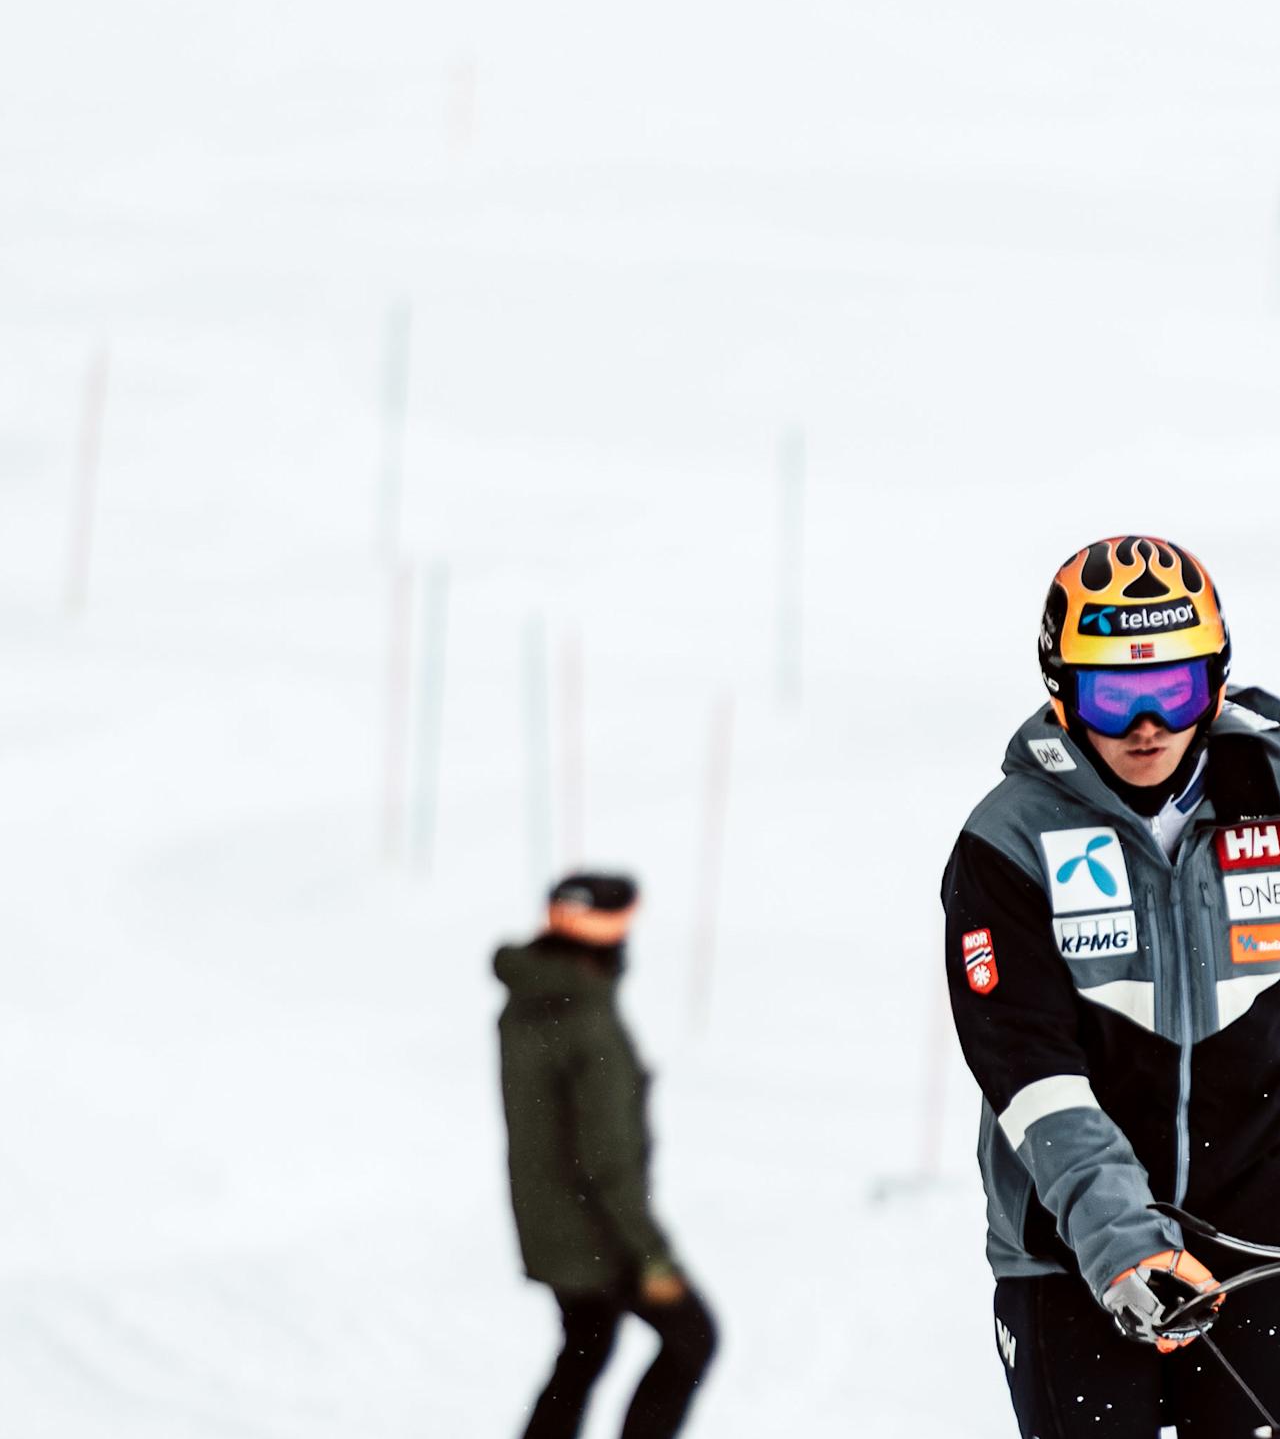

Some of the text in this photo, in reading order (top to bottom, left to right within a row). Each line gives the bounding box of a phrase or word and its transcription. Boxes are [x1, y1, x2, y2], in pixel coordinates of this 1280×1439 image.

[1120, 603, 1194, 630] telenor
[1037, 742, 1064, 769] DNB
[1225, 825, 1280, 860] HH
[964, 932, 988, 948] NOR
[1061, 931, 1129, 952] KPMG
